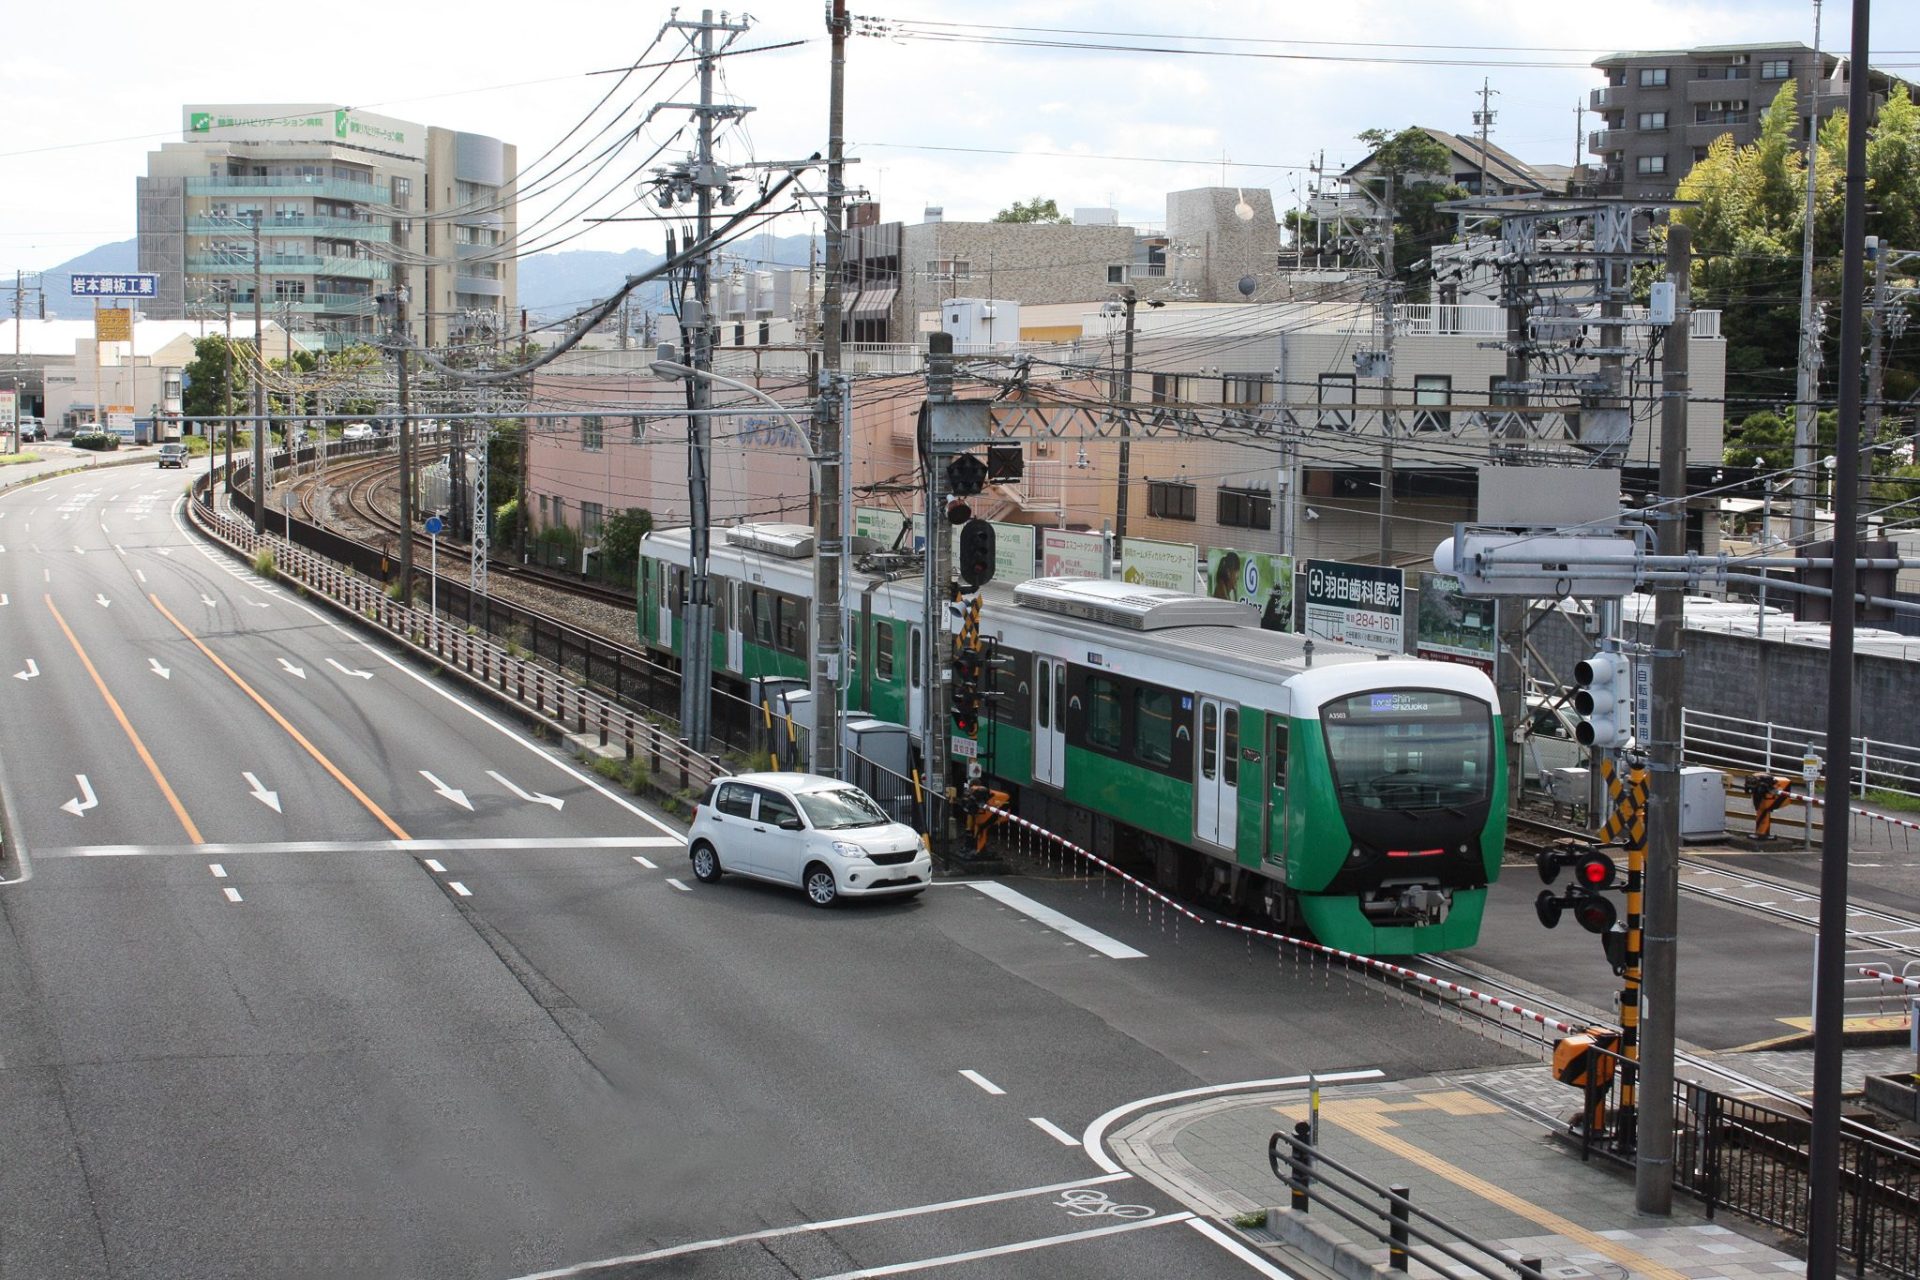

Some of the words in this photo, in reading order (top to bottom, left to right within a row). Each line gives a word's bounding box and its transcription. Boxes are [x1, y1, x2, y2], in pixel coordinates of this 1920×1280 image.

[73, 277, 152, 293] 岩本鋼板工業
[1324, 575, 1400, 608] 羽田歯科医院
[1355, 612, 1400, 632] 284-1611
[1638, 669, 1649, 741] 自転車専用
